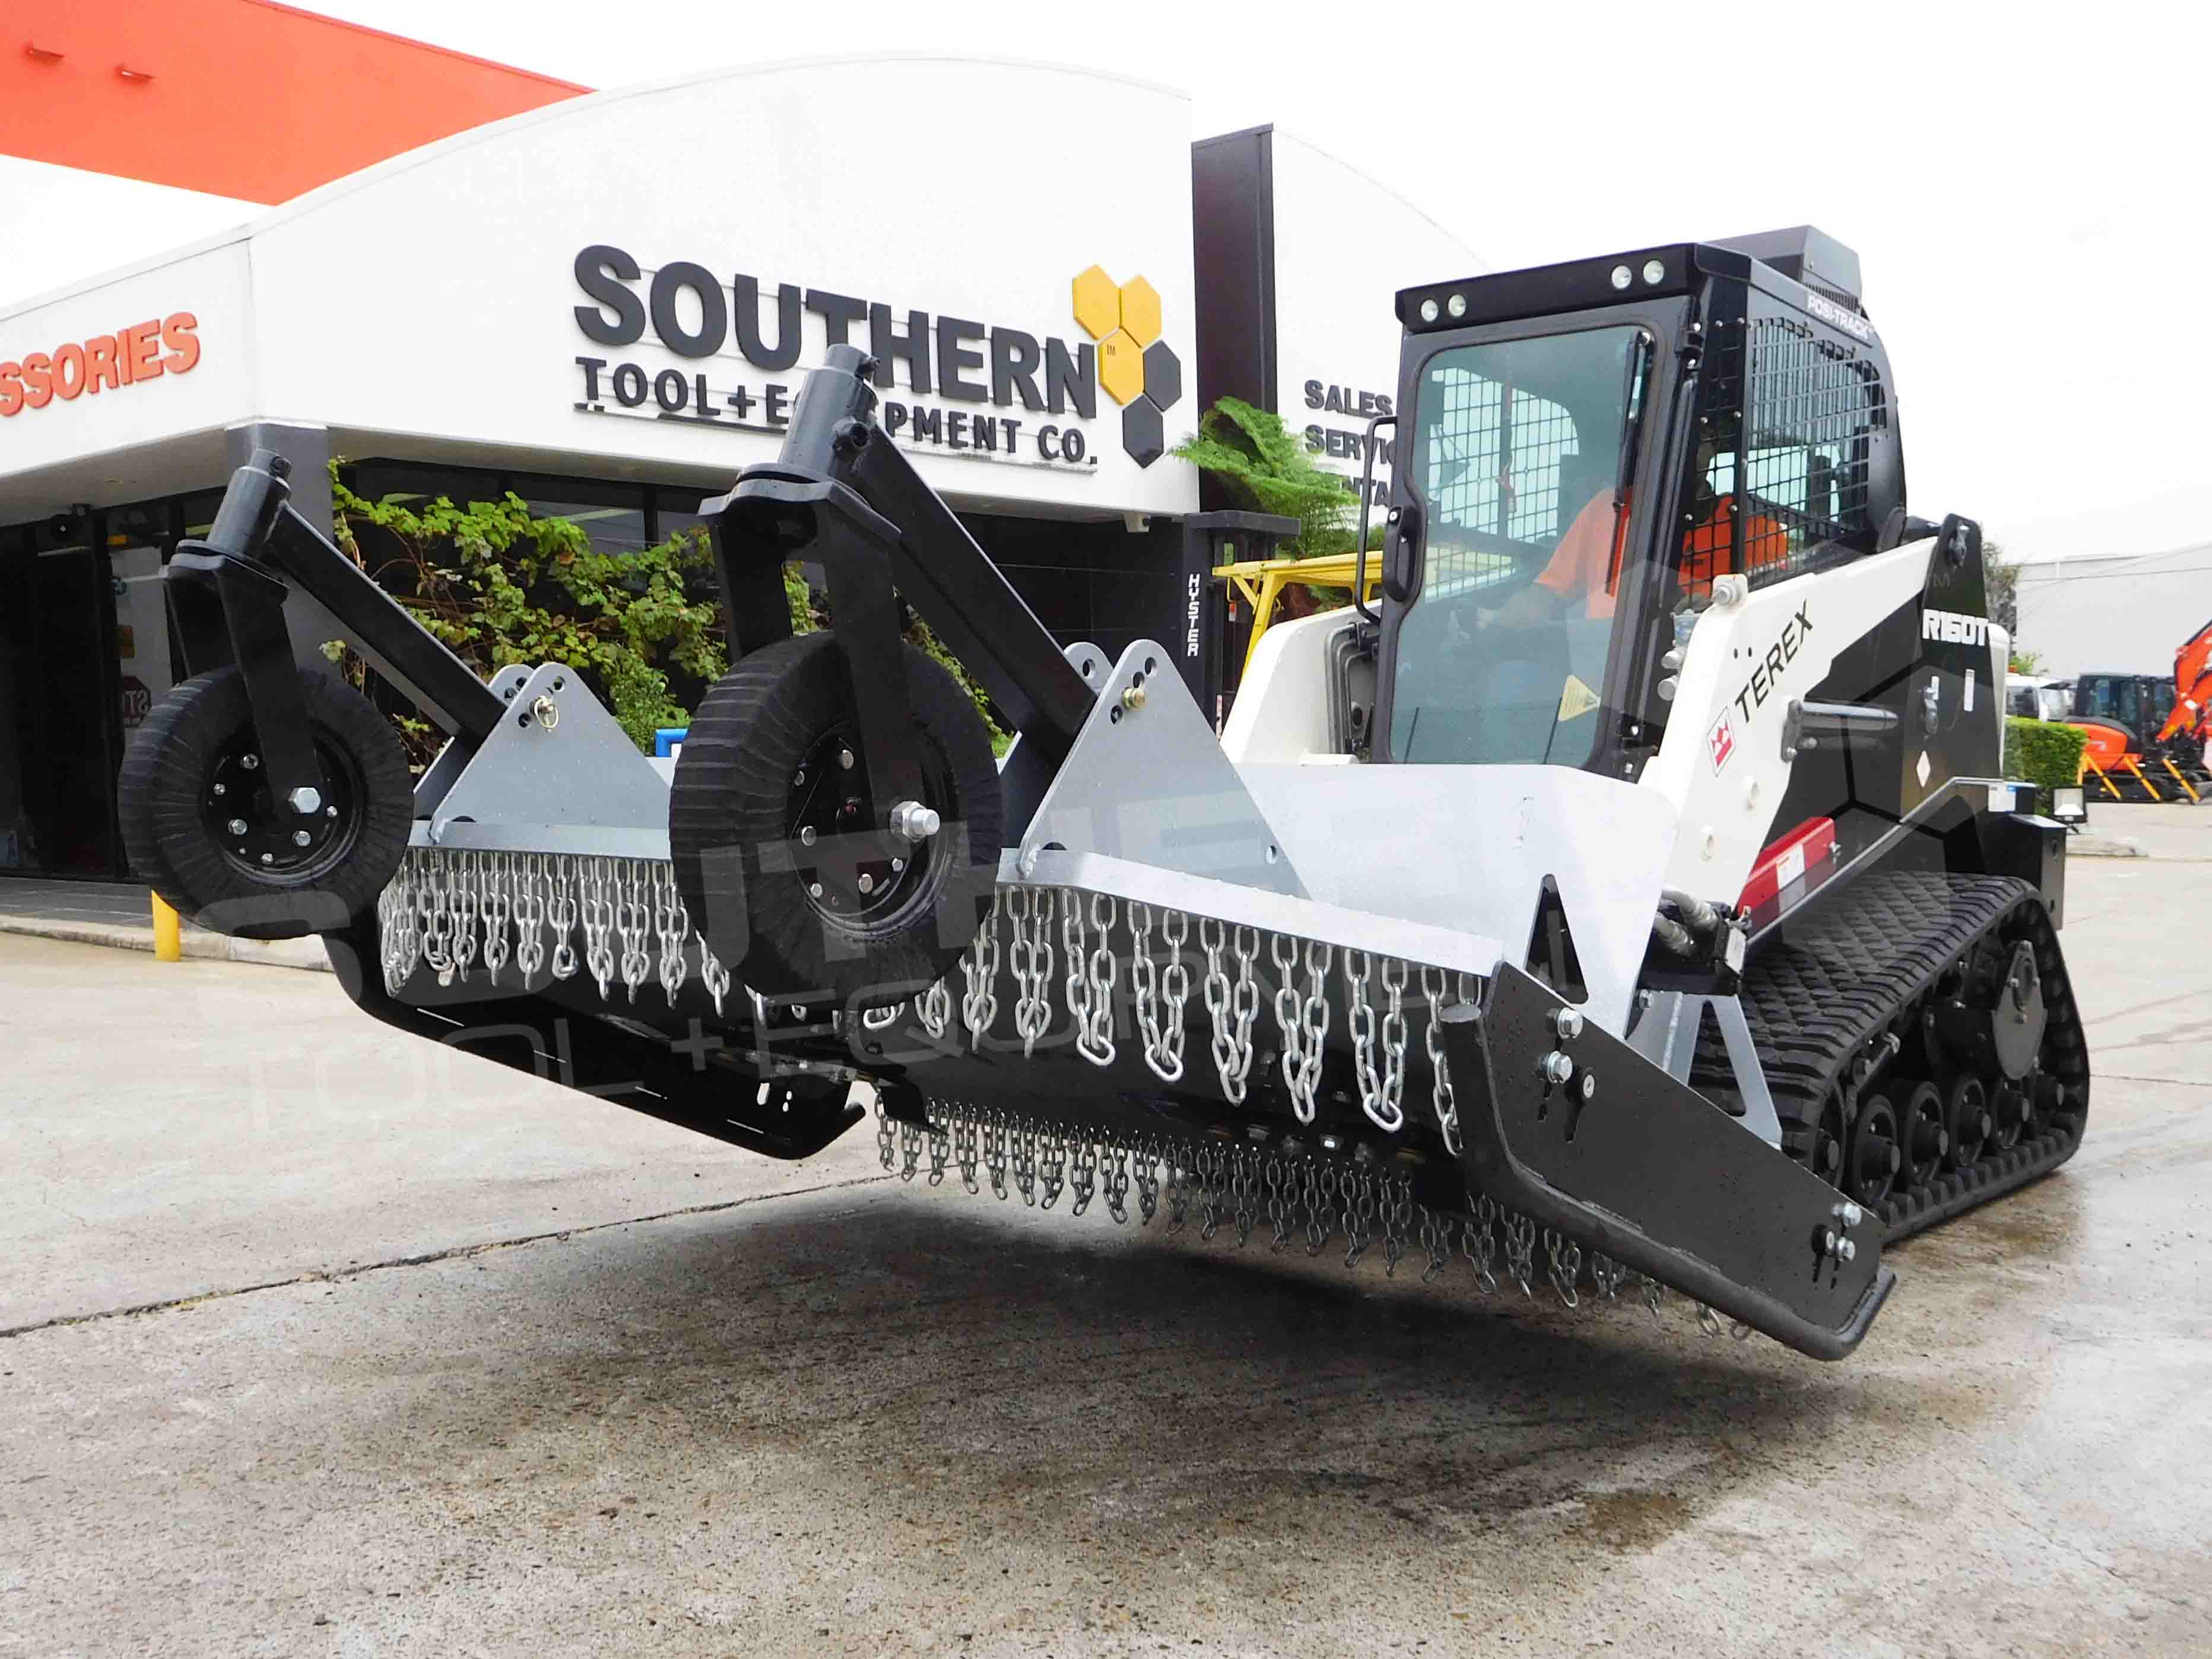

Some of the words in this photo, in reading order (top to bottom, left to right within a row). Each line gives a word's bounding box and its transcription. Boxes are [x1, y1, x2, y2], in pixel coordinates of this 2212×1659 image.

[574, 245, 1097, 419] SOUTHERN
[1304, 379, 1394, 419] SALES
[1187, 573, 1200, 656] HYSTER
[1734, 598, 1813, 724] TEREX
